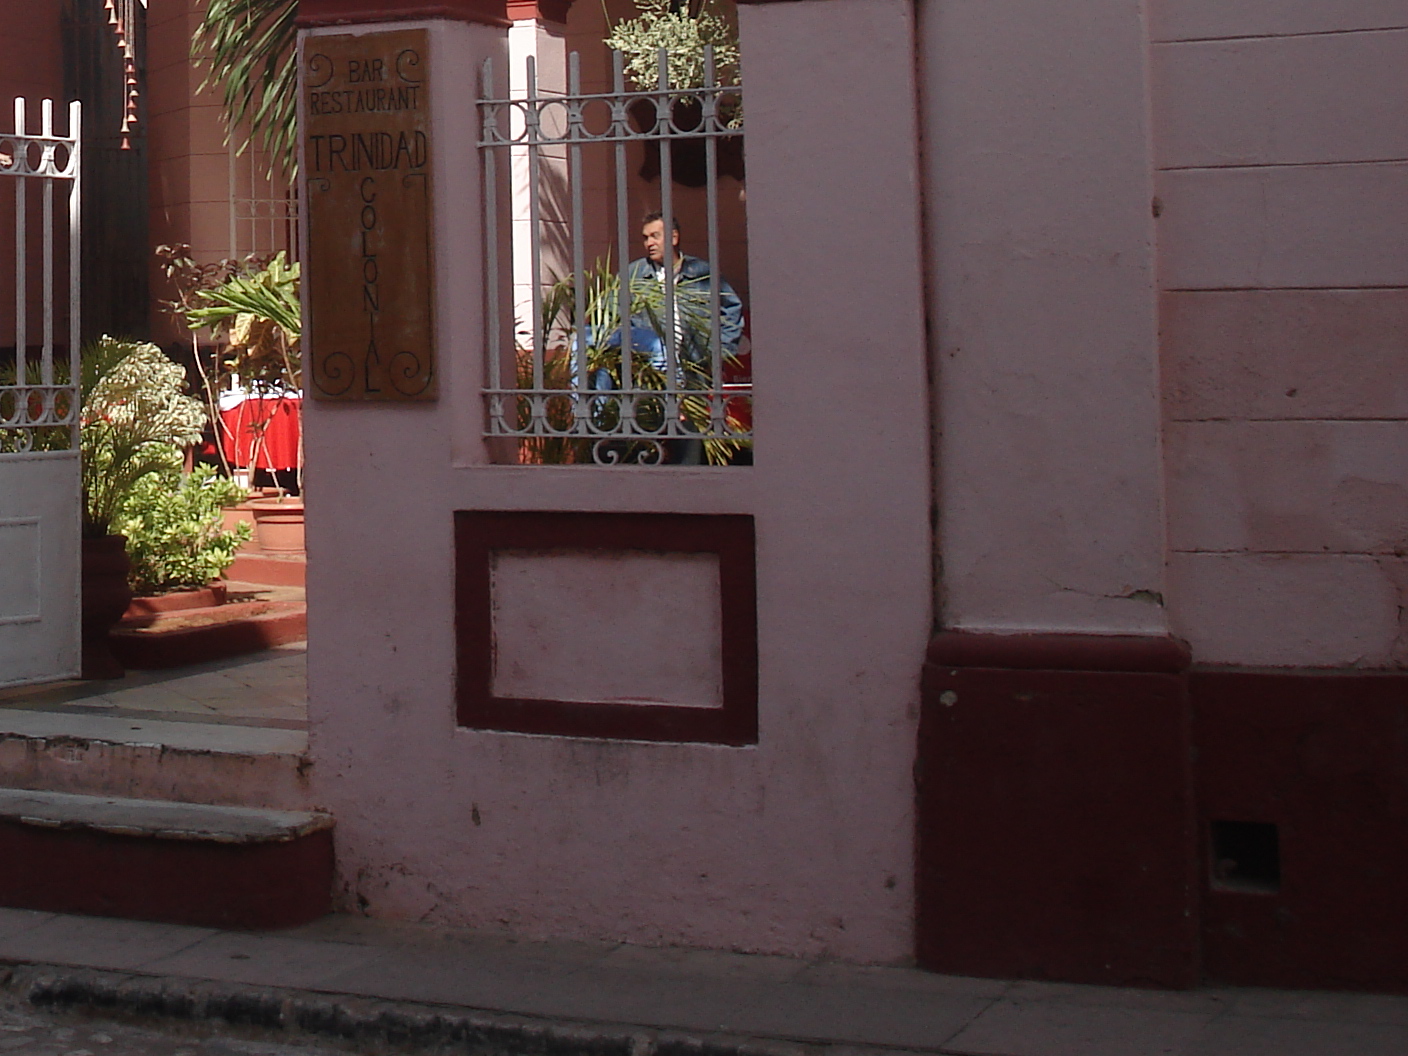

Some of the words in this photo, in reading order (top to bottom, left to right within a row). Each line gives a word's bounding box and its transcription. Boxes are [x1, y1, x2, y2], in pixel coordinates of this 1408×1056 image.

[349, 59, 383, 83] BAR
[310, 86, 420, 115] RESTAURANT
[310, 131, 427, 172] TRINIDAD
[361, 177, 380, 392] COLONIAL
